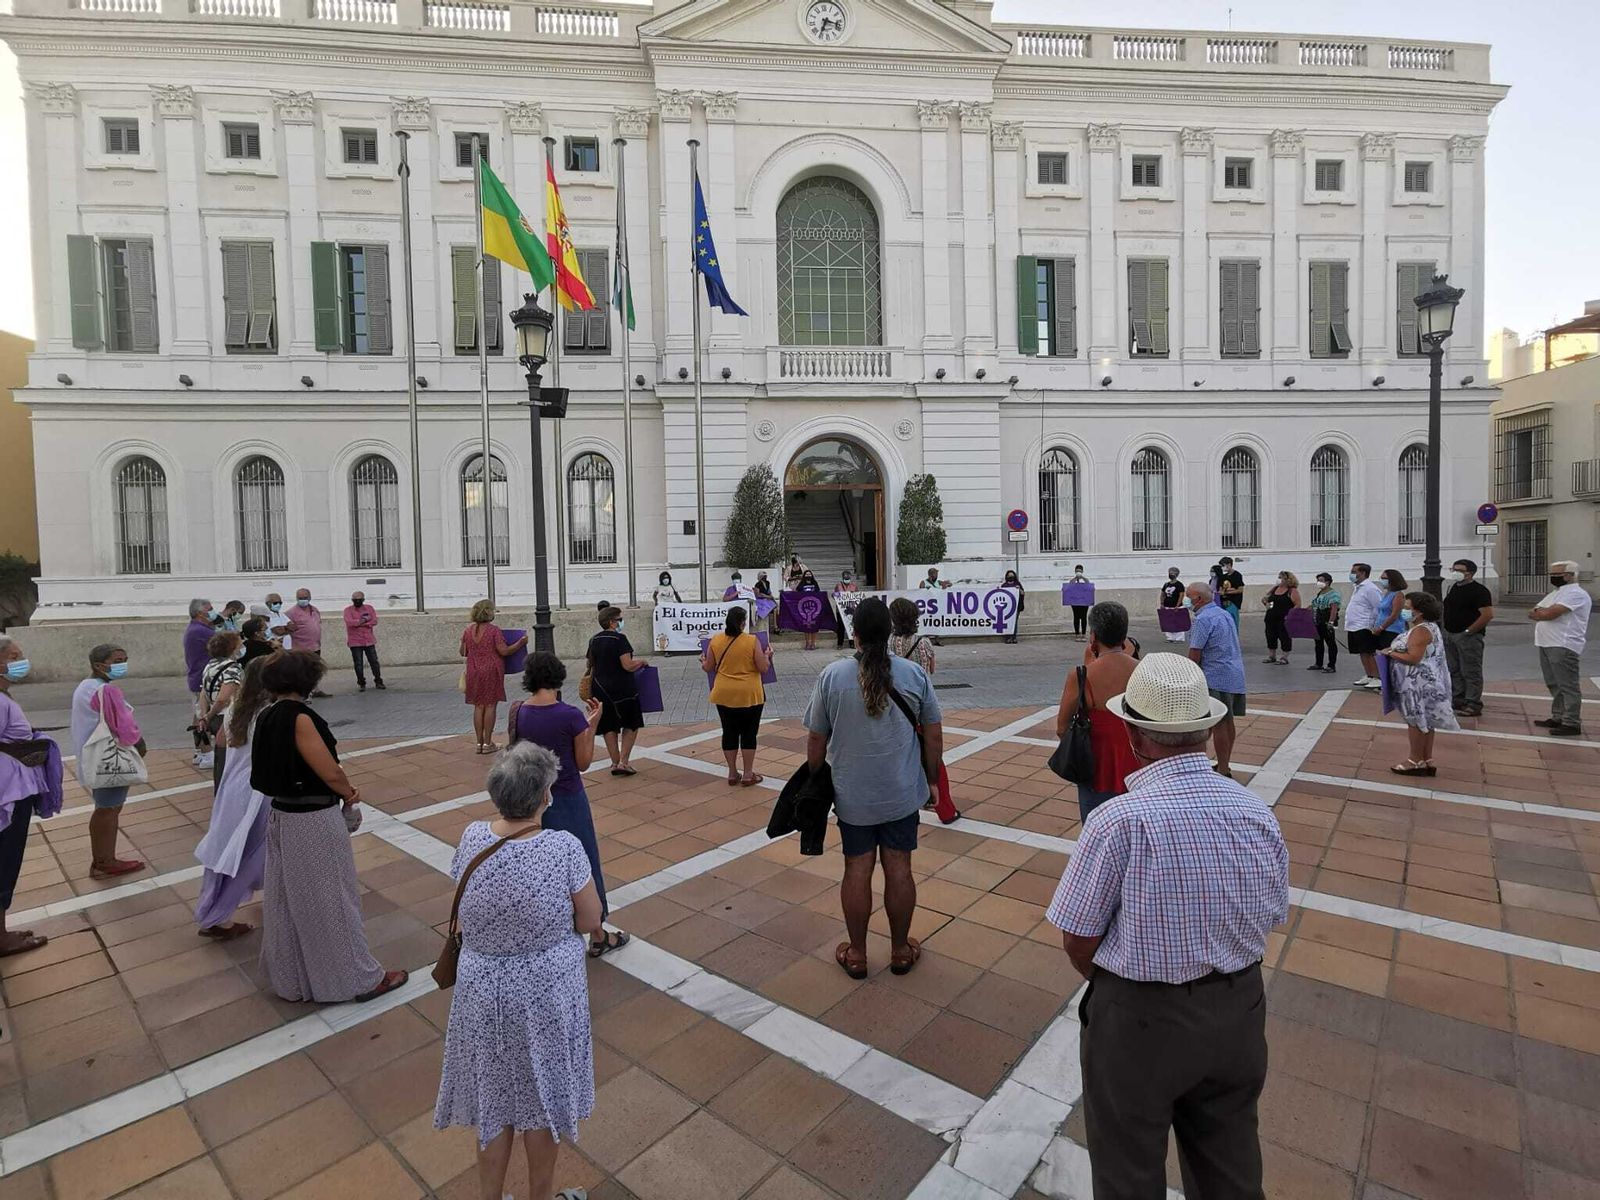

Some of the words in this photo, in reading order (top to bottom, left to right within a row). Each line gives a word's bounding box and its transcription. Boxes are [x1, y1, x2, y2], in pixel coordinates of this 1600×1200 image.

[915, 598, 939, 615] es
[946, 591, 979, 615] NO
[680, 608, 727, 618] feminis
[671, 620, 683, 631] al
[686, 620, 724, 634] poder
[923, 615, 992, 627] violaciones
